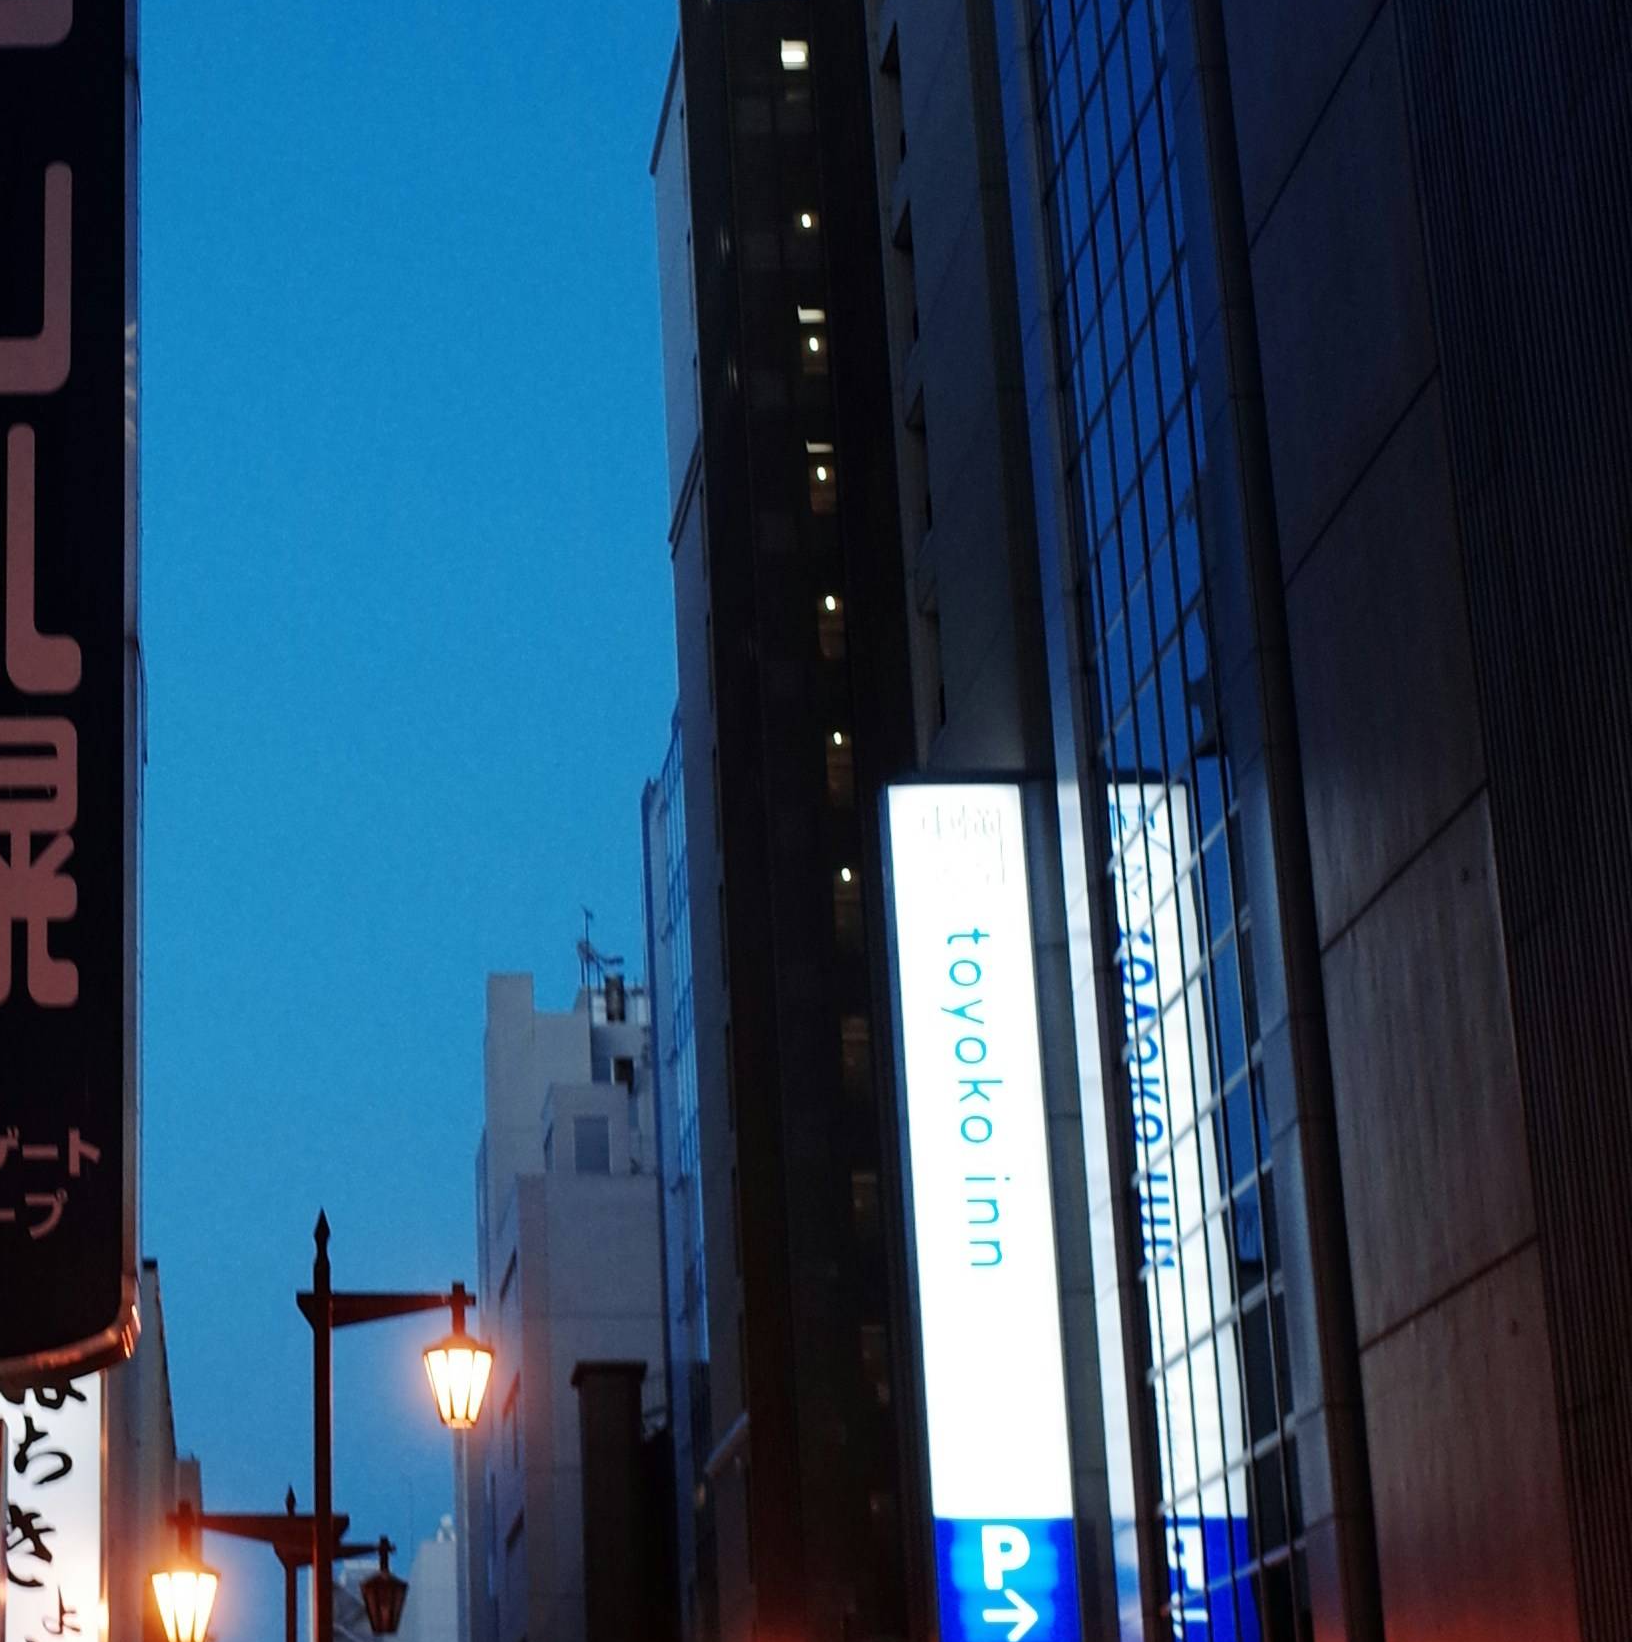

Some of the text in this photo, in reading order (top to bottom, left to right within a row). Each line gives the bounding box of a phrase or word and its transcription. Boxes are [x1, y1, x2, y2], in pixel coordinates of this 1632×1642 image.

[940, 927, 1004, 1145] toyoko
[963, 1175, 1011, 1268] inn
[981, 1524, 1031, 1591] P
